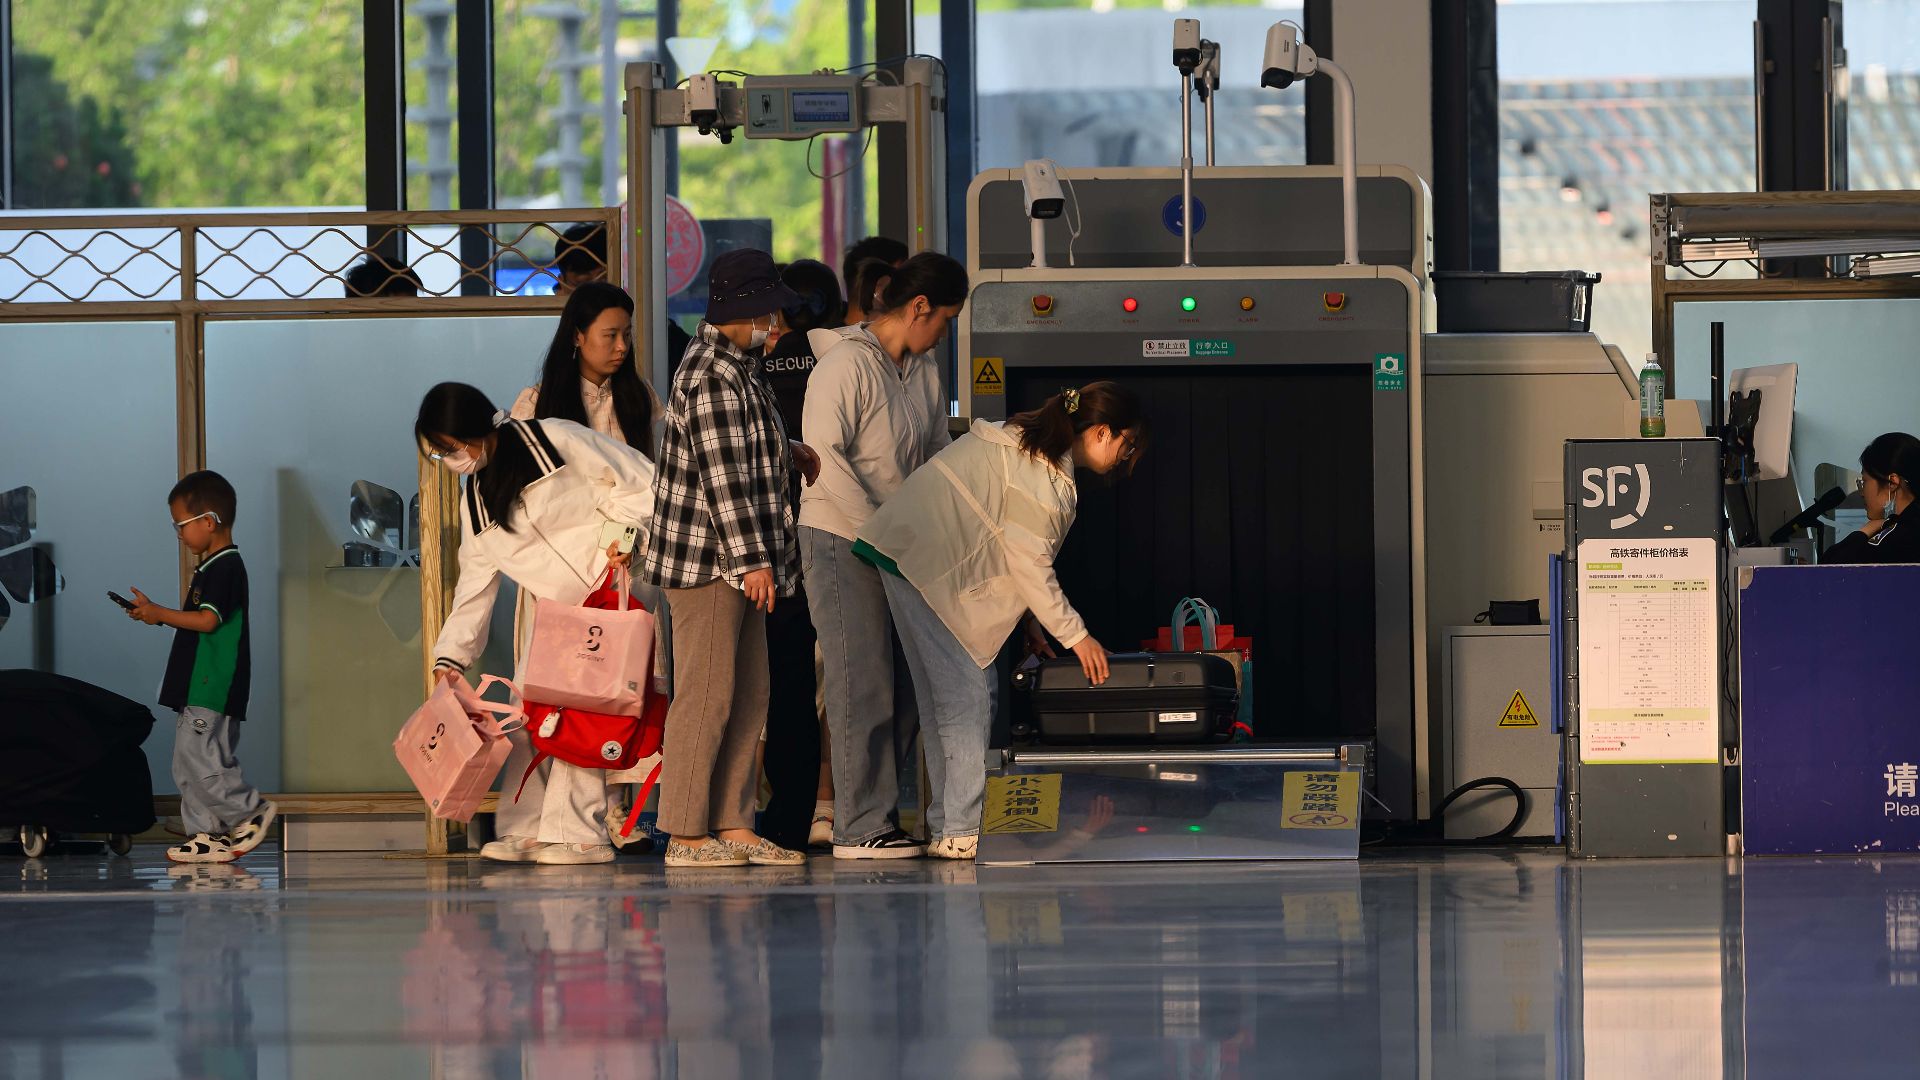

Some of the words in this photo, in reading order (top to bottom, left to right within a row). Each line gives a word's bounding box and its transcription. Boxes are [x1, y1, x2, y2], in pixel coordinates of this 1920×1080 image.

[1609, 547, 1689, 558] 高铁寄件柜价格表
[1002, 777, 1042, 816] 小心滑倒
[1301, 773, 1340, 811] 请勿踩踏
[1883, 762, 1919, 798] 请
